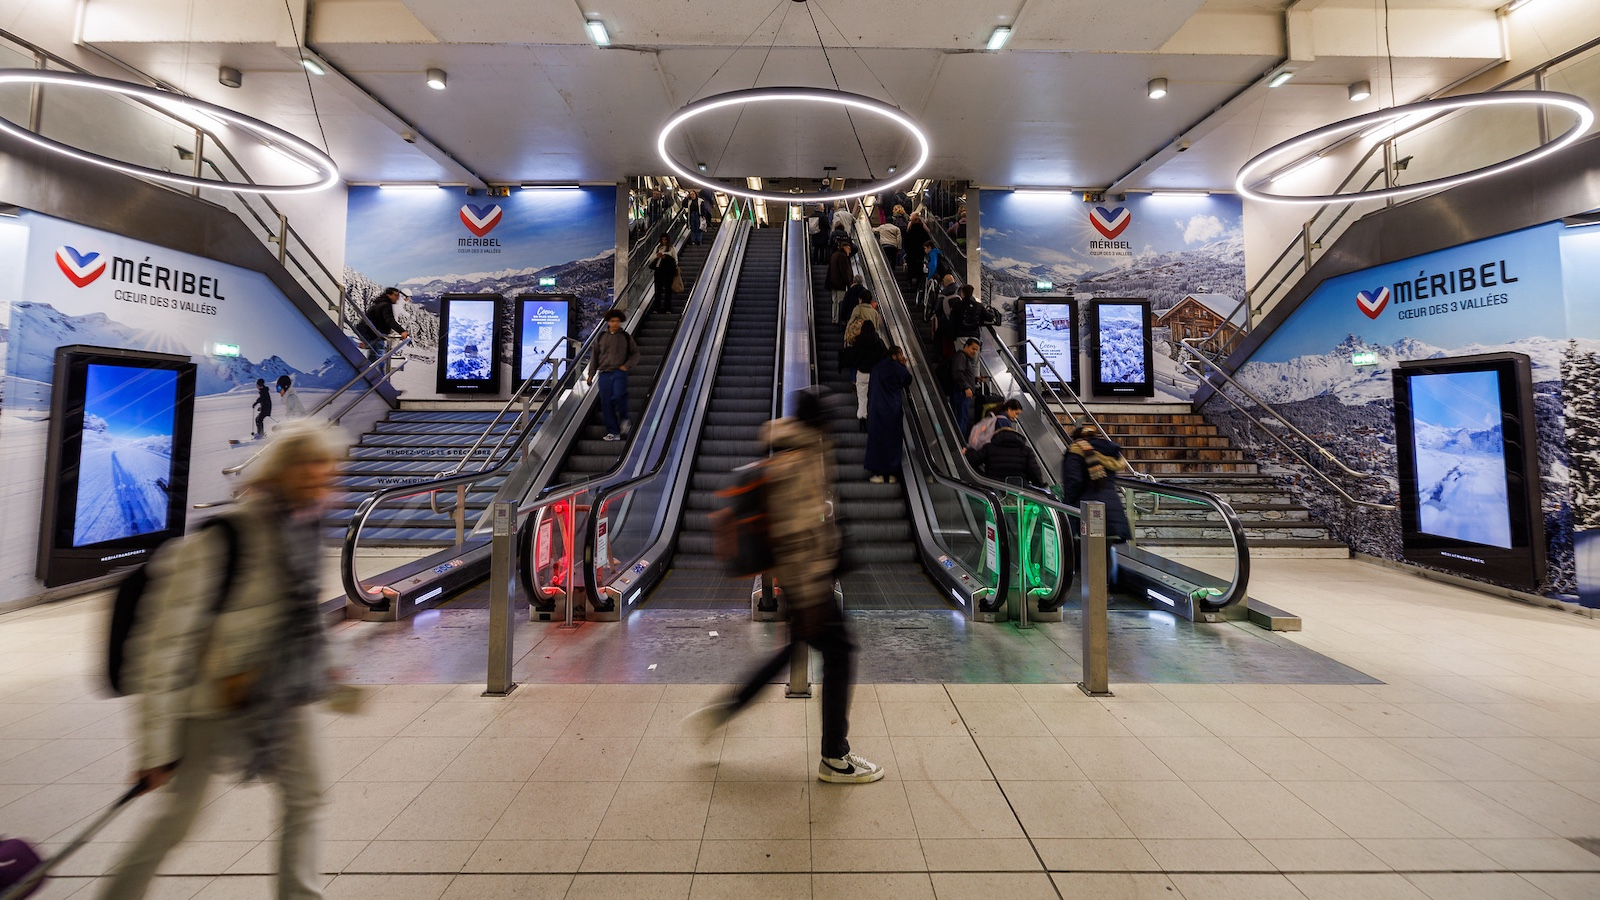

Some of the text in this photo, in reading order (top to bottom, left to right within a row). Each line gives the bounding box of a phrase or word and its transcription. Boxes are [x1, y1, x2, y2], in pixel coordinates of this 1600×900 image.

[458, 236, 501, 247] MÉRIBEL
[1090, 239, 1132, 249] MÉRIBEL
[111, 256, 225, 301] MÉRIBEL
[1393, 260, 1519, 304] MÉRIBEL
[114, 289, 217, 316] CŒUR DES 3 VALLÉES
[1398, 293, 1508, 320] CŒUR DES 3 VALLÉES
